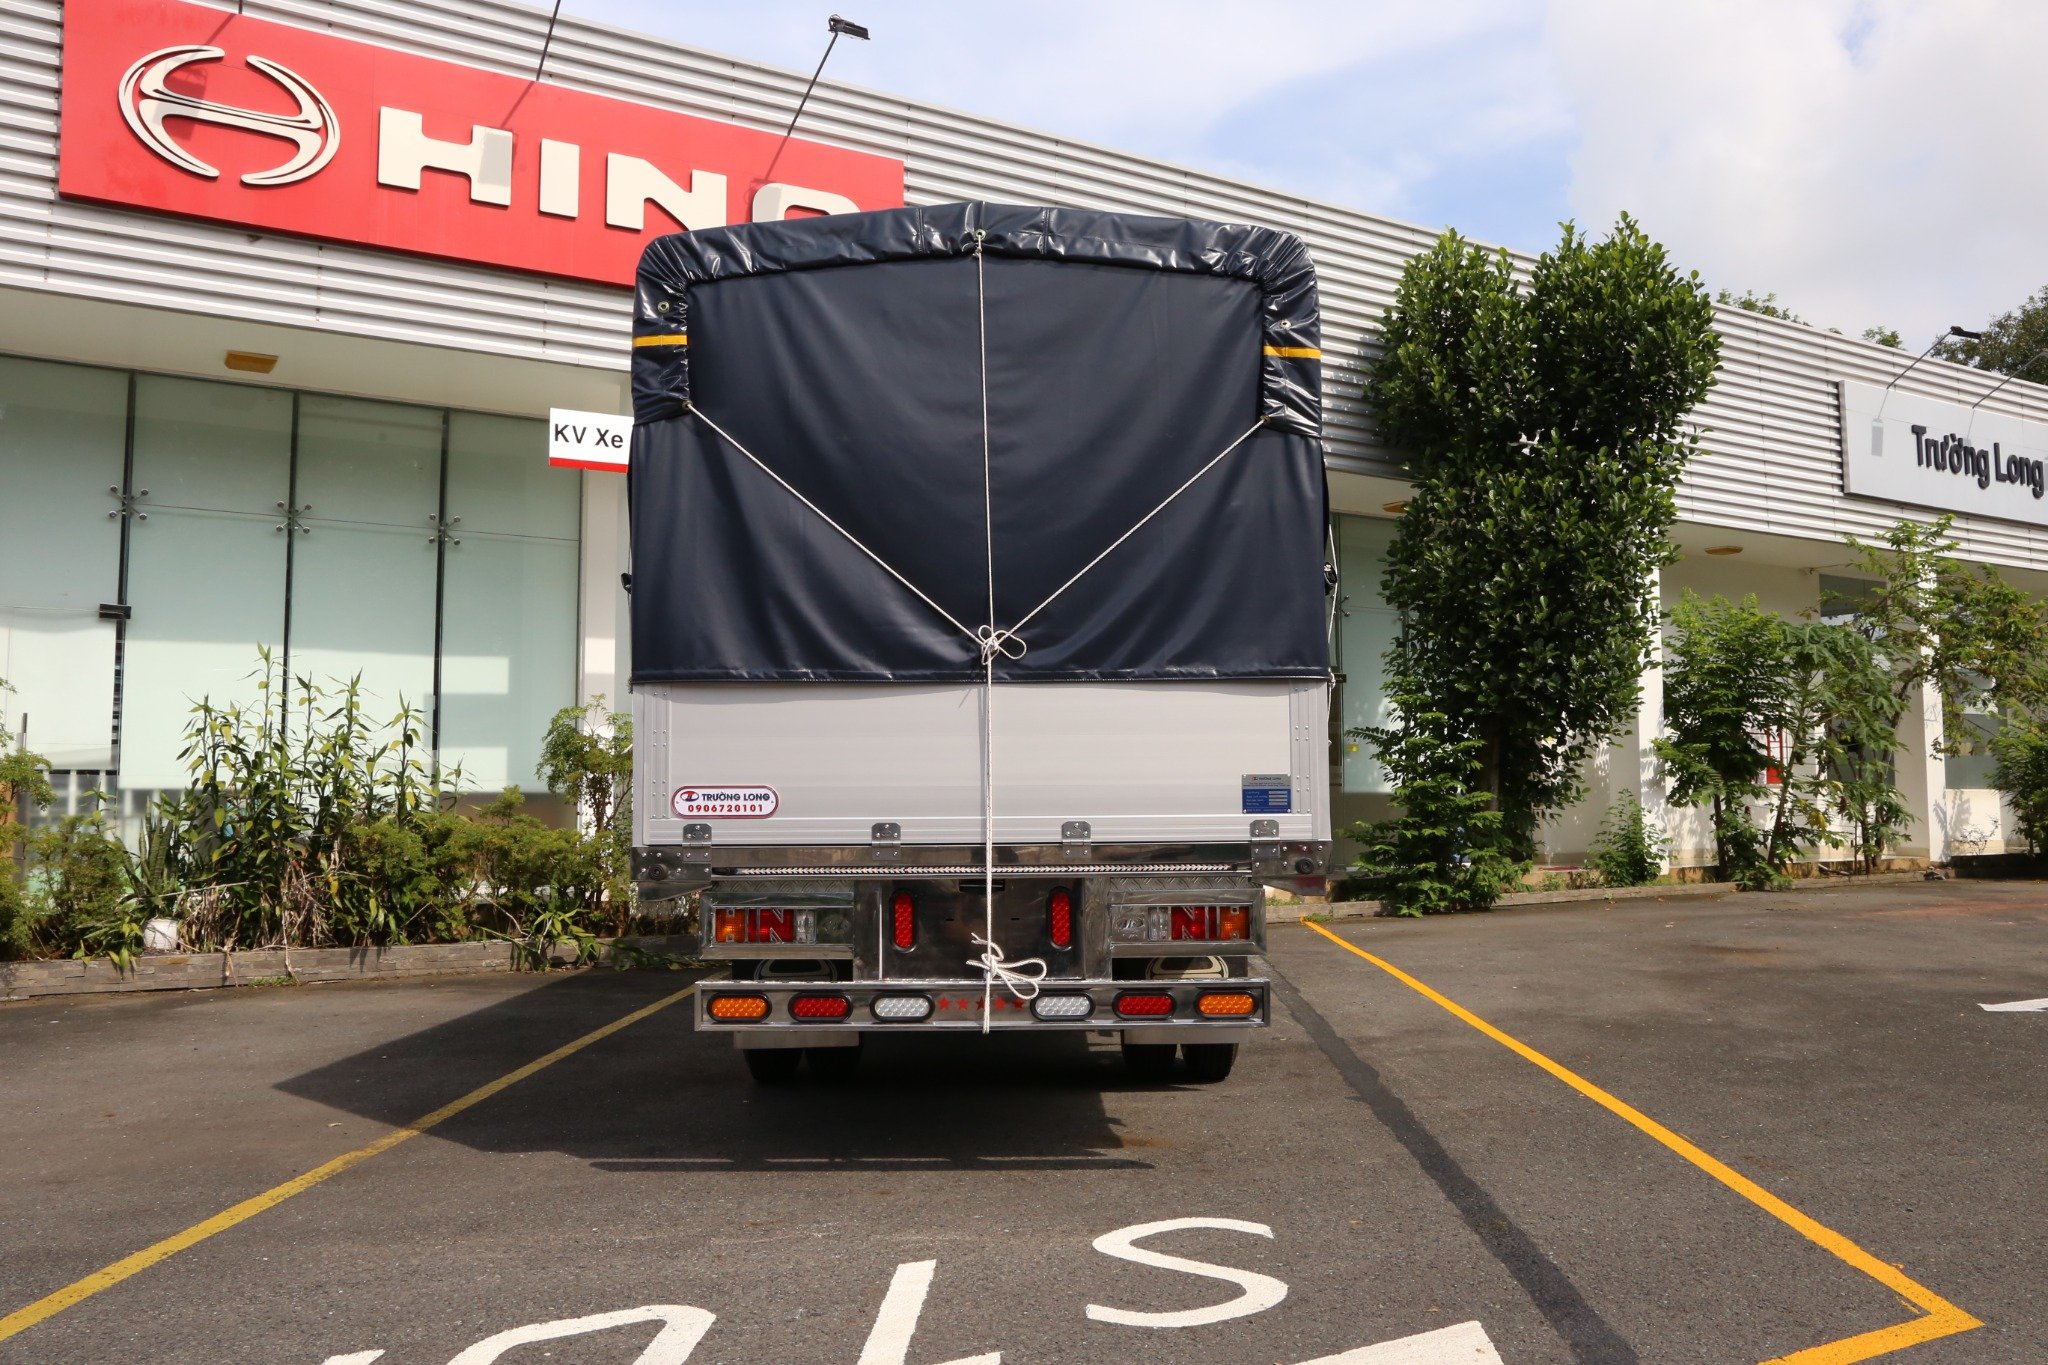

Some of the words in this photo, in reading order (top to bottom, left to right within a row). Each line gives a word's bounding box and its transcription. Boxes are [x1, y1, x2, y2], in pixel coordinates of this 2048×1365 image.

[554, 423, 587, 444] KV
[595, 428, 624, 449] Xe
[1911, 424, 1990, 490] Trường
[1993, 442, 2045, 499] Long
[701, 791, 741, 801] TRƯỜNG
[743, 793, 770, 801] LONG
[688, 804, 763, 812] 0906720101
